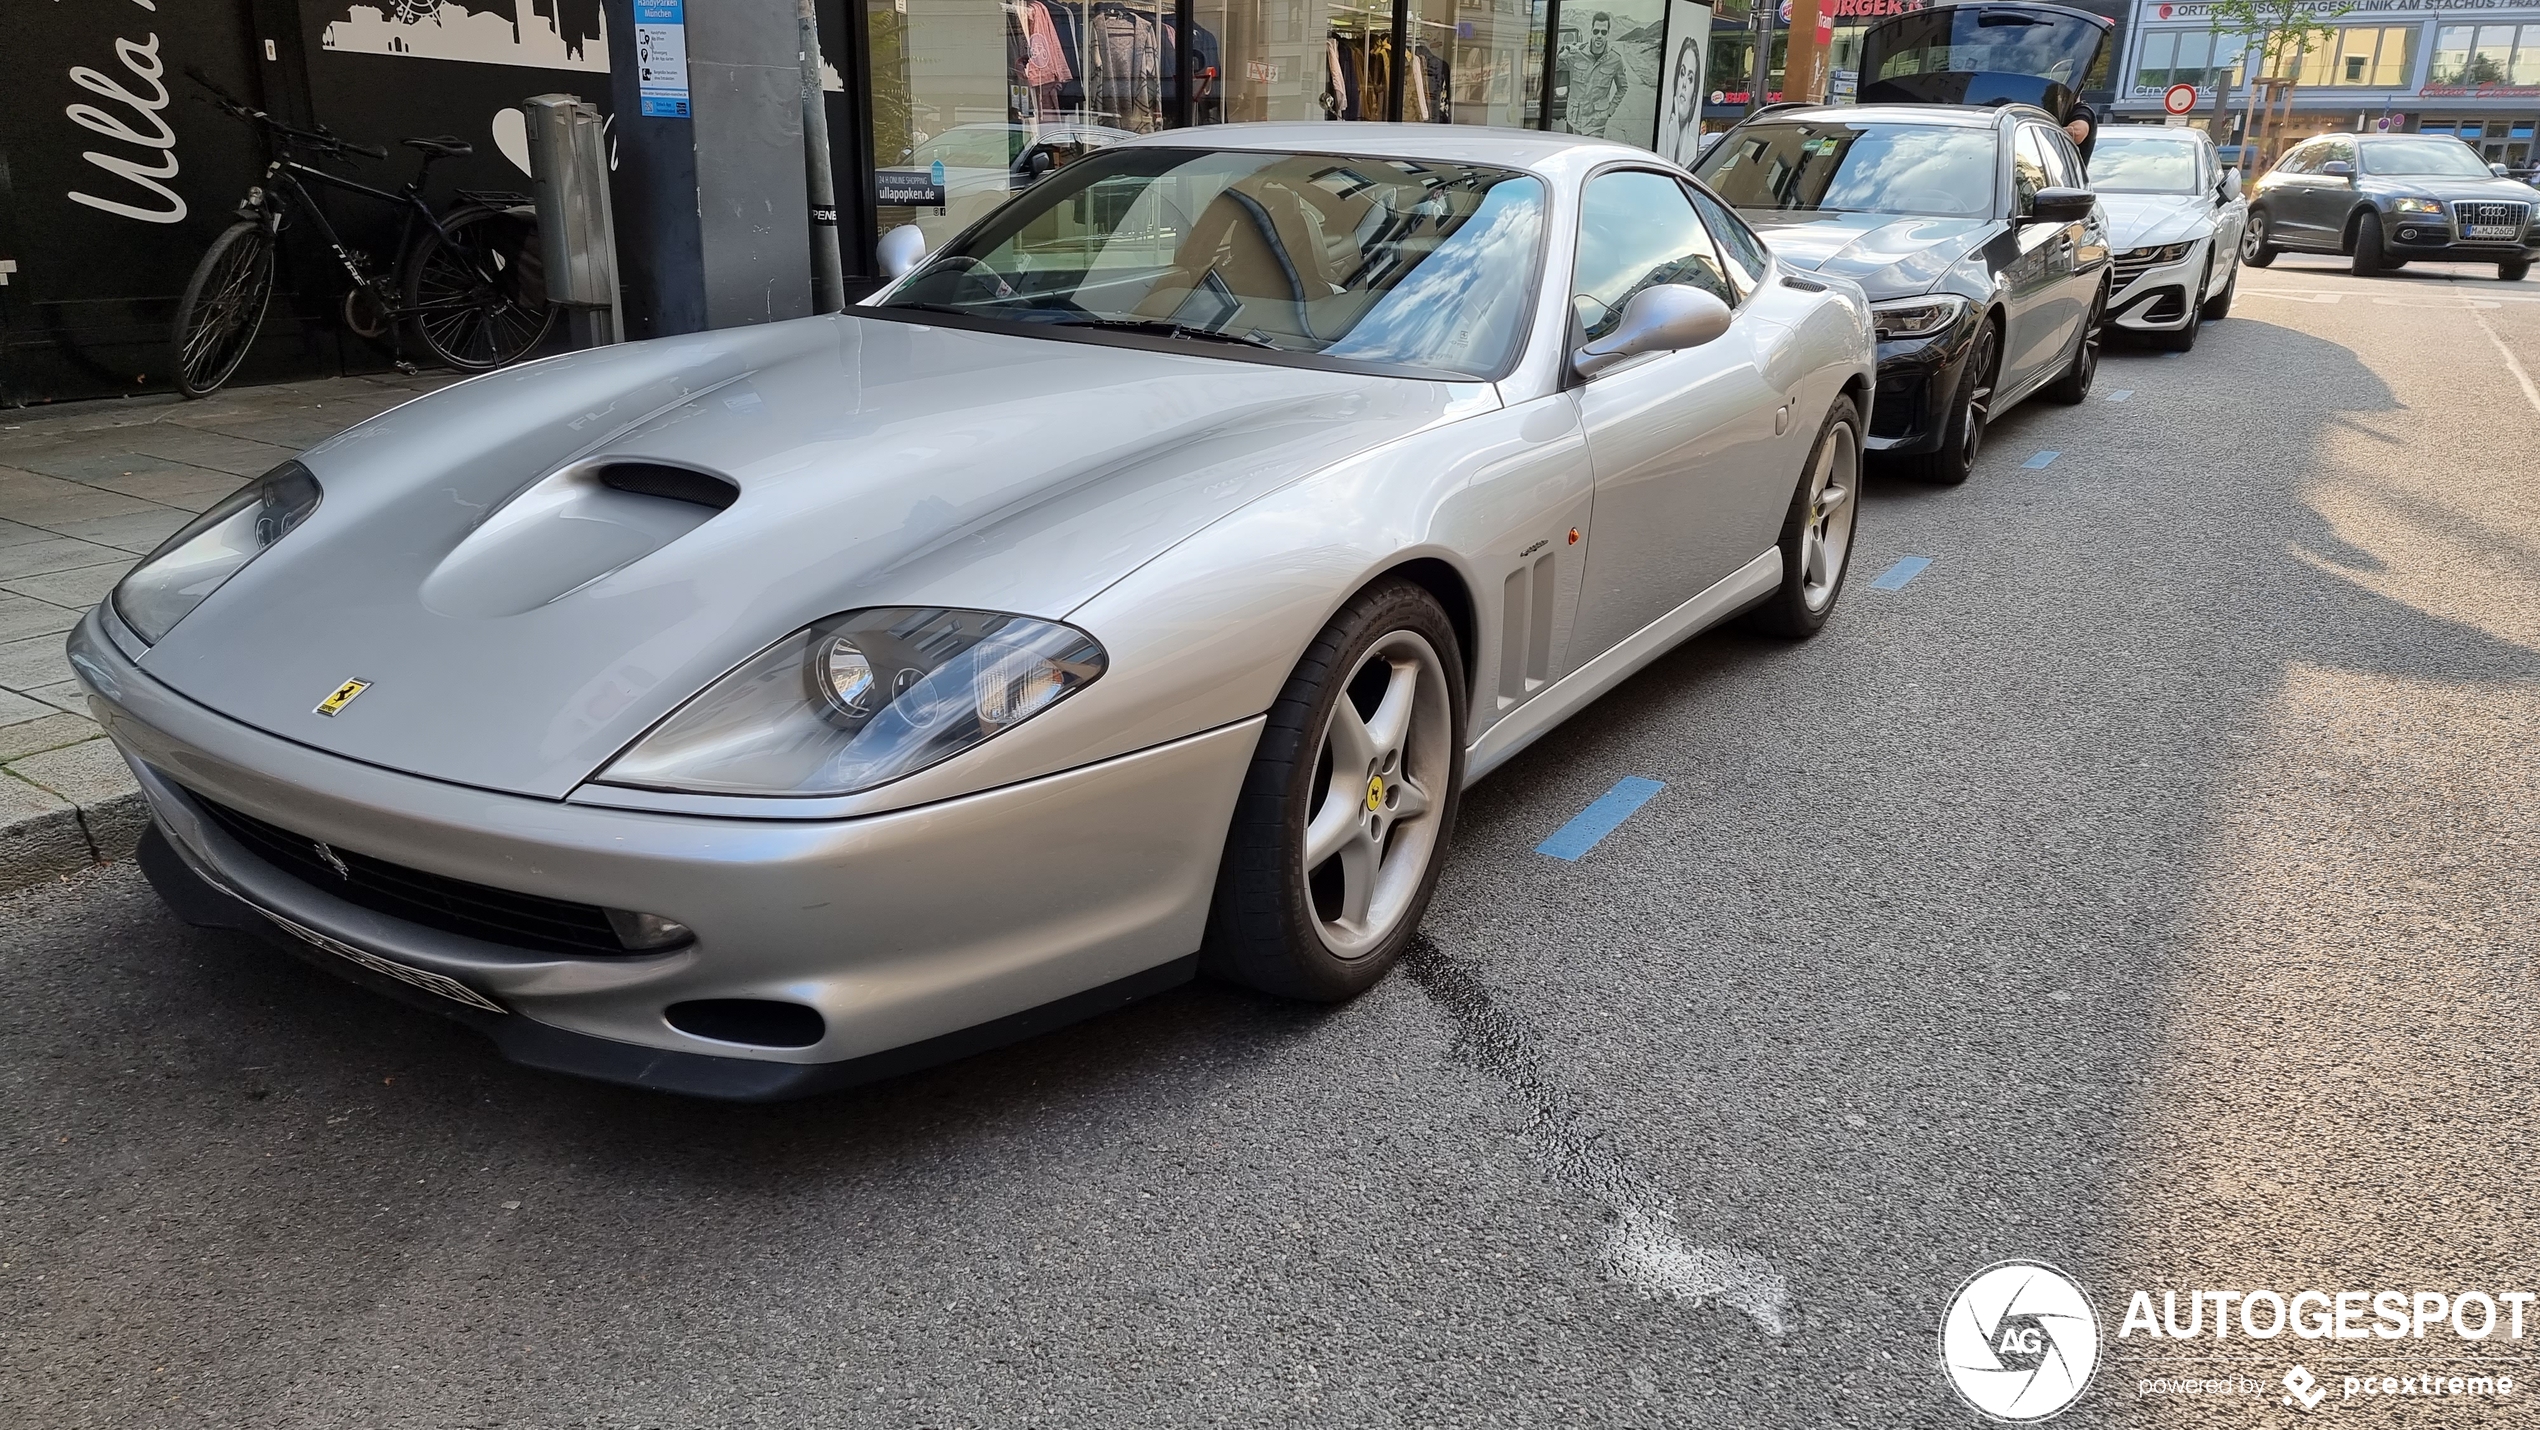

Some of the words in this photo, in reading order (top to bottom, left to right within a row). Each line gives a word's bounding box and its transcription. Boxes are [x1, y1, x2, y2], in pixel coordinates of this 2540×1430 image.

[2397, 0, 2420, 11] AM
[2424, 0, 2497, 9] STACHUS
[645, 9, 672, 17] München
[1818, 11, 1832, 29] Tram
[66, 31, 188, 224] Ulla
[879, 176, 885, 184] 24
[890, 176, 905, 185] ONLINE
[905, 177, 927, 185] SHOPPING
[879, 186, 935, 202] ullapopken.de
[2494, 227, 2514, 236] 2605
